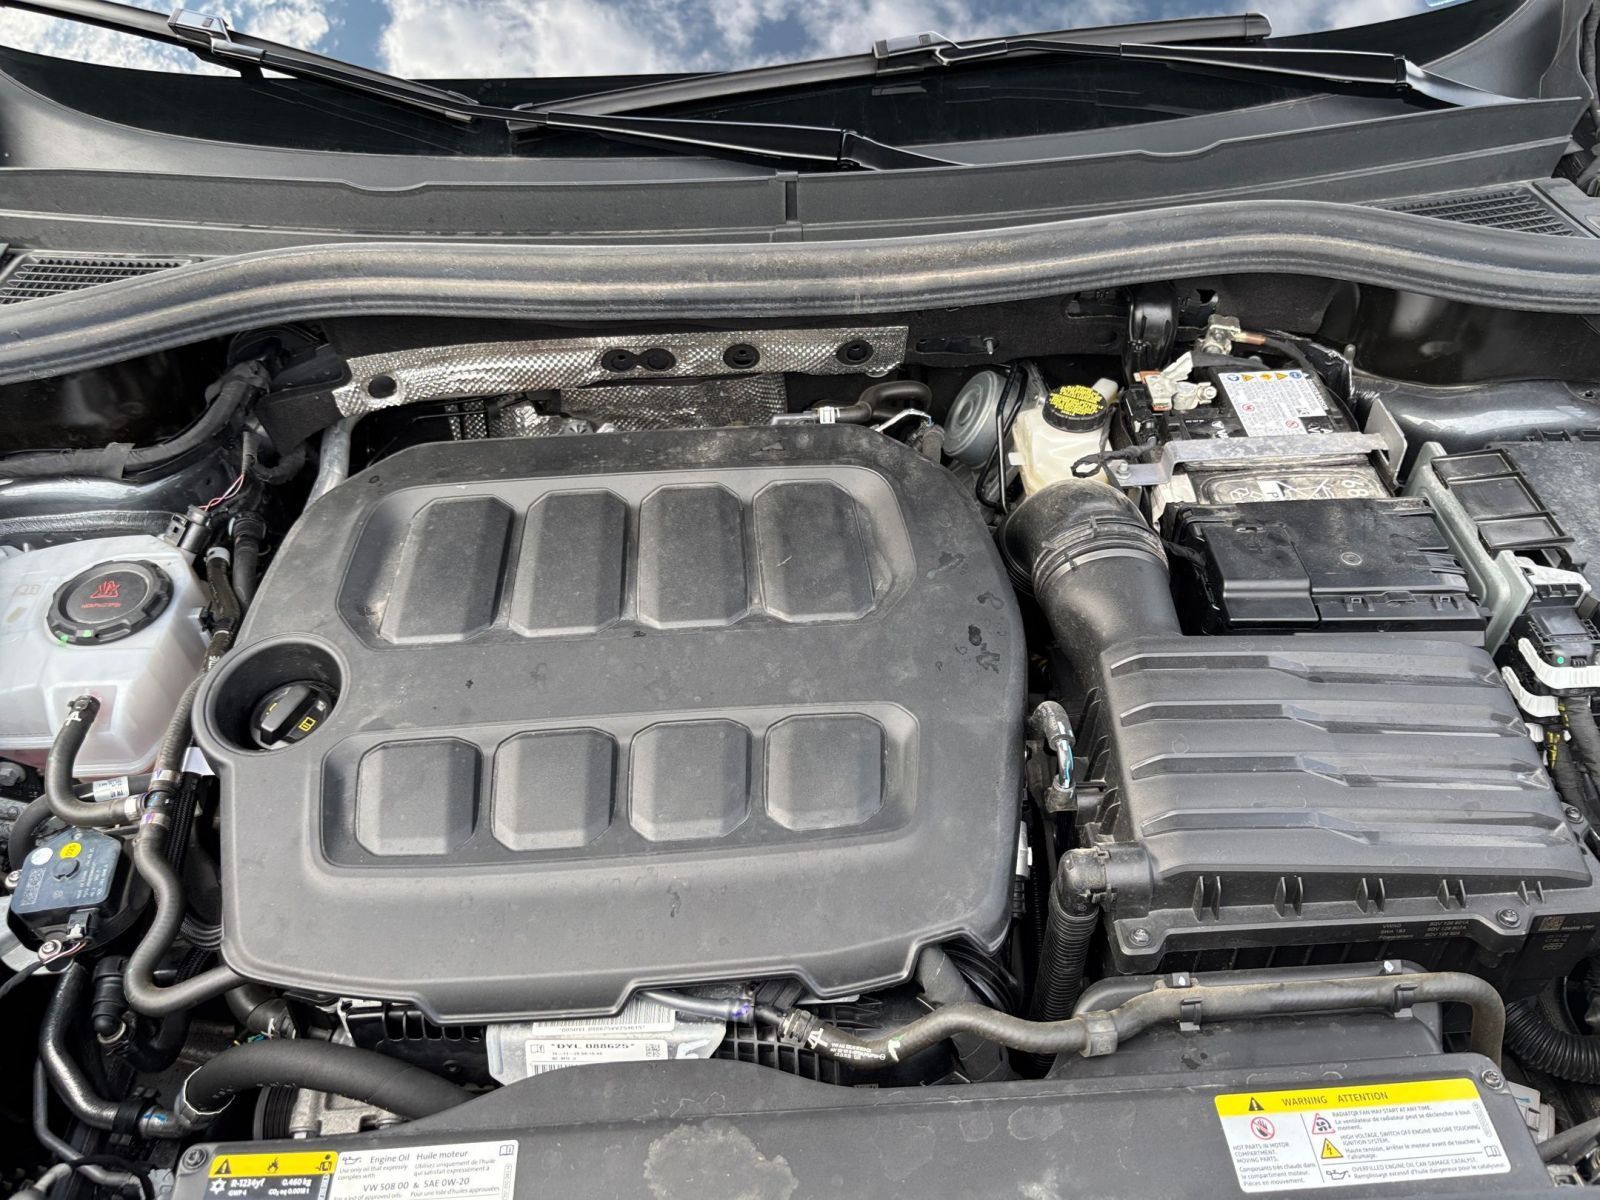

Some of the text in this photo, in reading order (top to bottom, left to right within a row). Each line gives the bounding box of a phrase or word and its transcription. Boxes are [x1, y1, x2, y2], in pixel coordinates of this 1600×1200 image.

[1282, 1091, 1388, 1106] WARNING ATTENTION
[1425, 1110, 1454, 1118] déclencher
[370, 1154, 410, 1165] Engine Oil
[417, 1150, 468, 1160] Huile moteur
[383, 1164, 408, 1172] expressly
[436, 1160, 470, 1169] uniquement
[1239, 1165, 1271, 1173] Composants
[1352, 1164, 1384, 1172] OVERFILLED
[1248, 1172, 1287, 1180] compartiment
[1354, 1171, 1390, 1180] Remplissage
[1430, 1166, 1457, 1175] dangereux
[230, 1178, 265, 1191] R-1234yf
[302, 1178, 312, 1187] kg
[363, 1184, 378, 1192] VW
[380, 1182, 396, 1191] 508
[397, 1182, 409, 1190] 00
[424, 1180, 440, 1188] SAE
[441, 1177, 470, 1187] 0W-20
